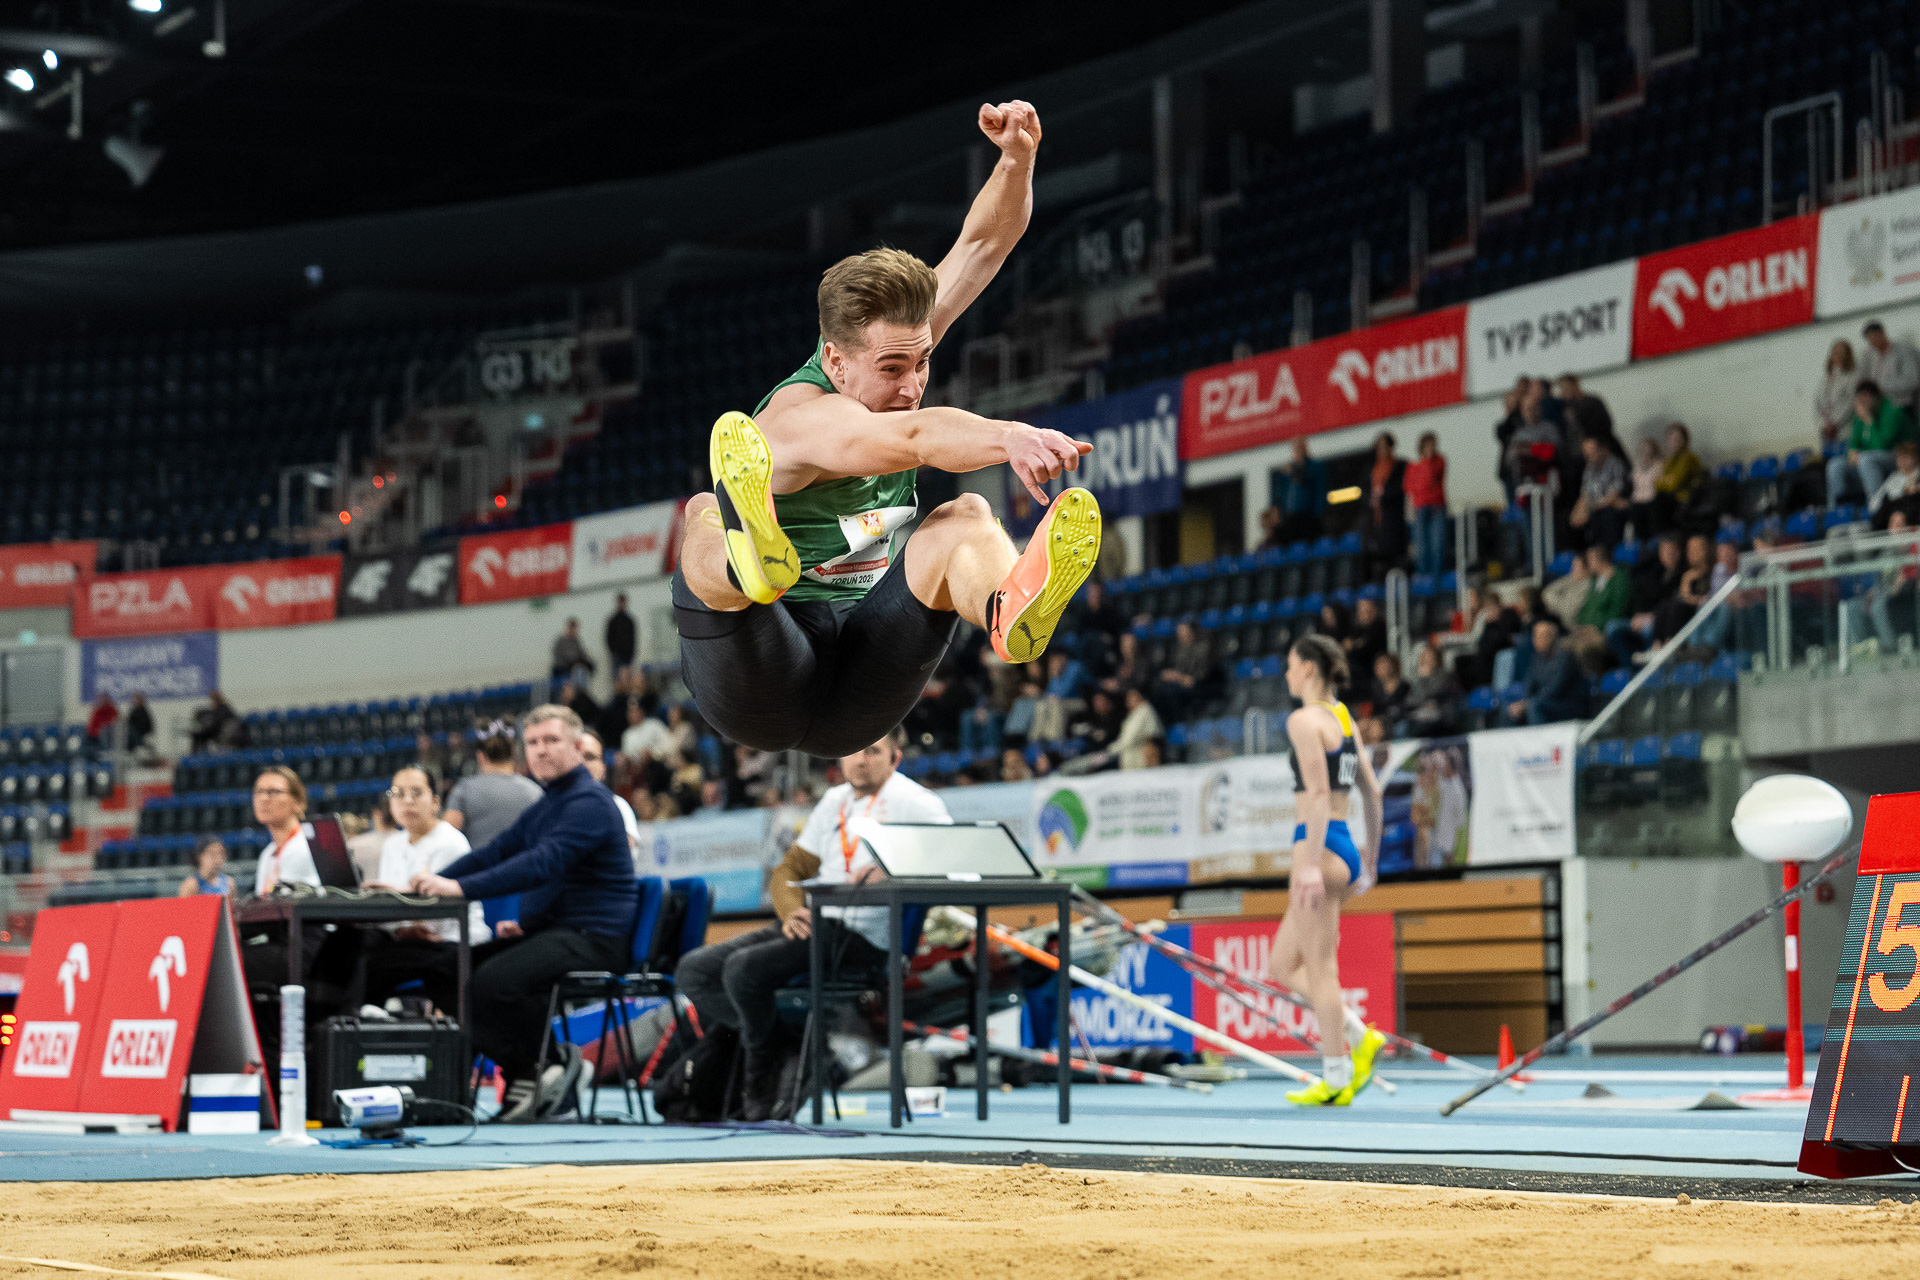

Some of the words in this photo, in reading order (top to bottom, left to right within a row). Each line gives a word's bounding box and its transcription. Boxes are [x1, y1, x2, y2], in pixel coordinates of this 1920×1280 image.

[1704, 247, 1809, 311] ORLEN
[1482, 319, 1533, 362] TVP
[1537, 299, 1621, 351] SPORT
[1373, 335, 1461, 390] ORLEN
[1200, 362, 1301, 427] PZLA
[1052, 394, 1179, 492] ORUŃ
[506, 543, 569, 578] ORLEN
[89, 578, 192, 617] PZLA
[264, 574, 336, 606] ORLEN
[1867, 881, 1920, 1012] 5
[22, 1028, 75, 1068] ORLEN
[110, 1026, 171, 1068] ORLEN
